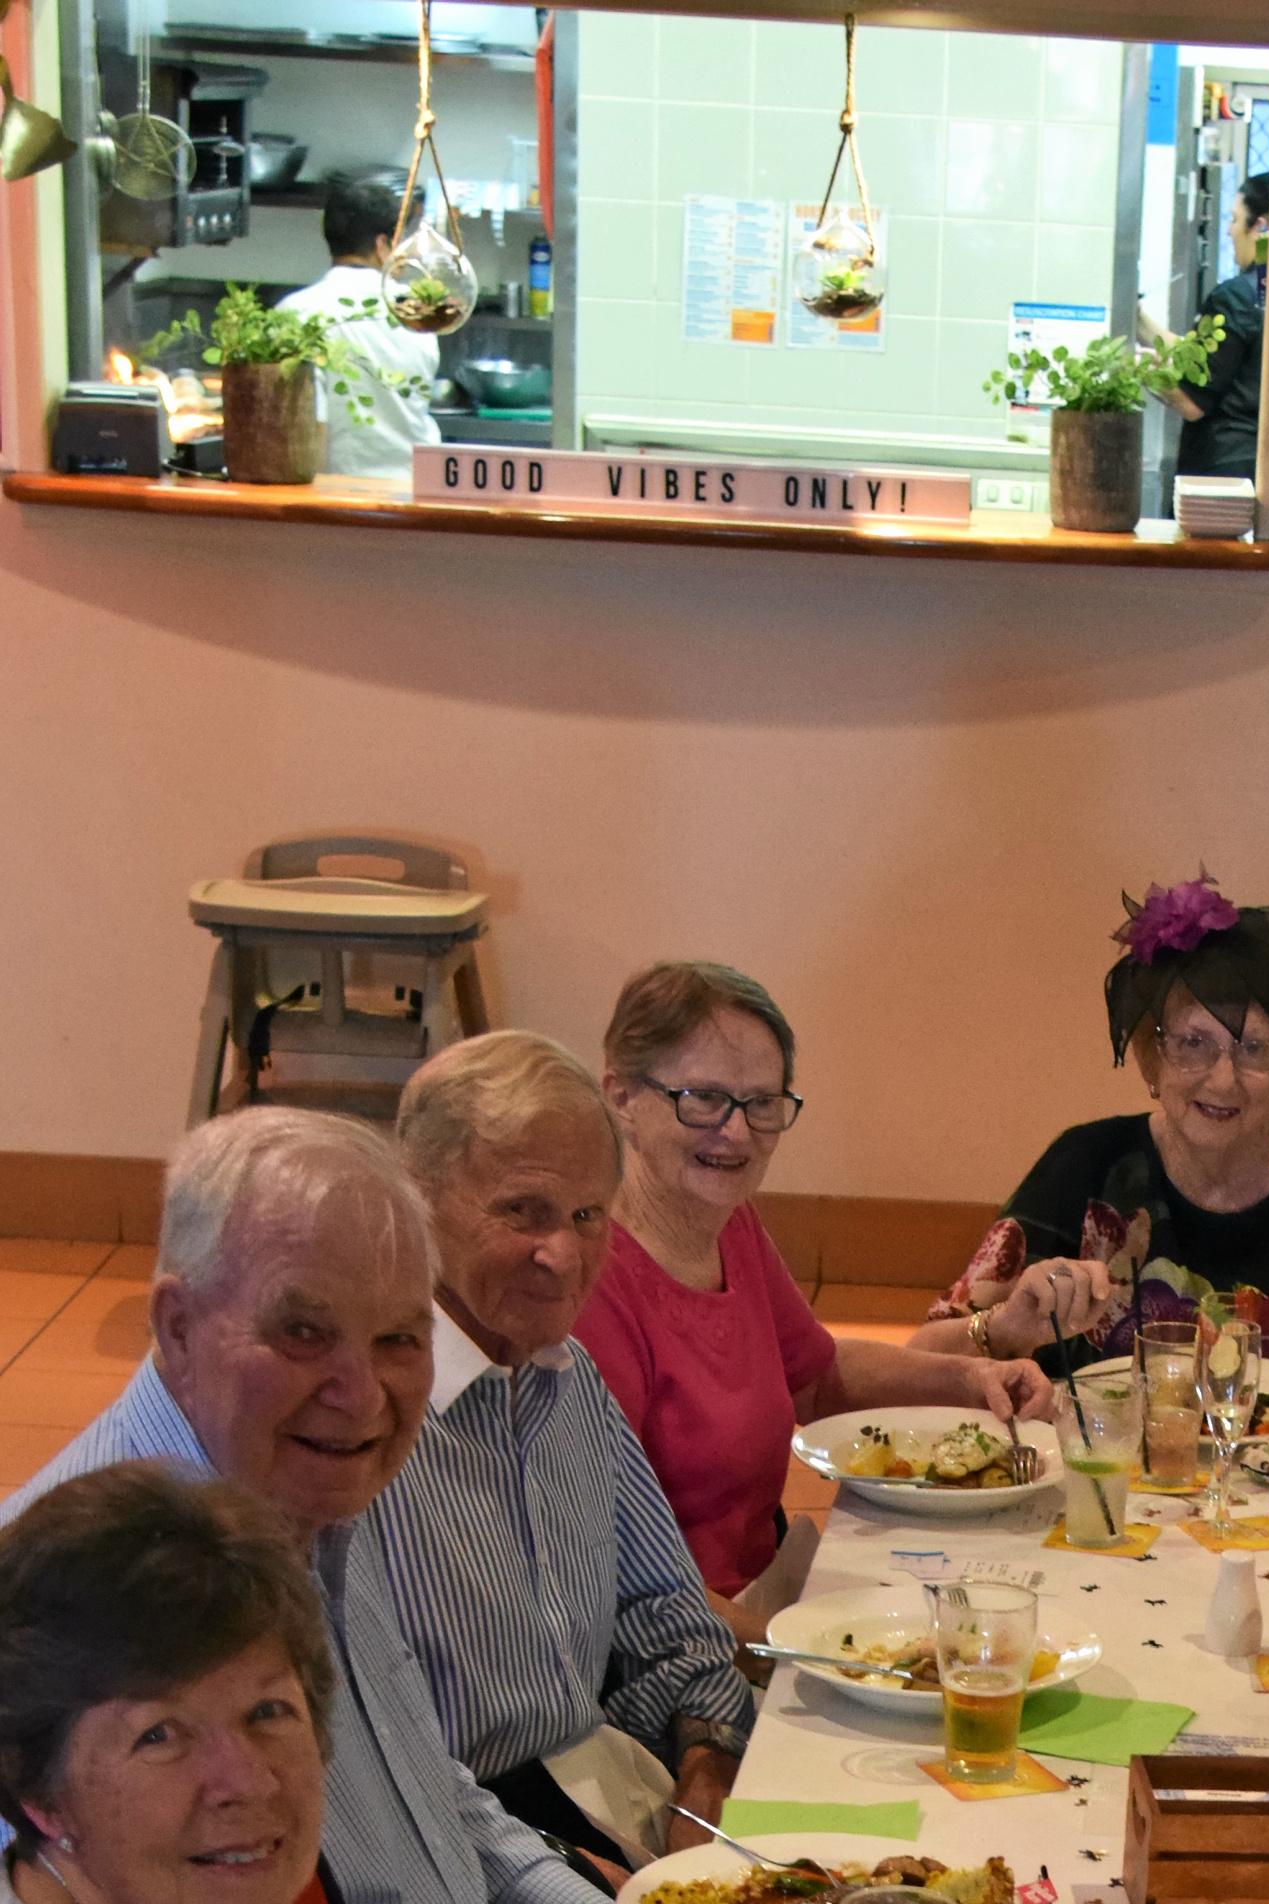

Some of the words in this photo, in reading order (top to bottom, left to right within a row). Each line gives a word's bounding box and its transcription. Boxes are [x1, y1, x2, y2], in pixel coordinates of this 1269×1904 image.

[444, 456, 545, 493] GOOD
[607, 465, 737, 503] VIBES
[784, 476, 909, 513] ONLY!
